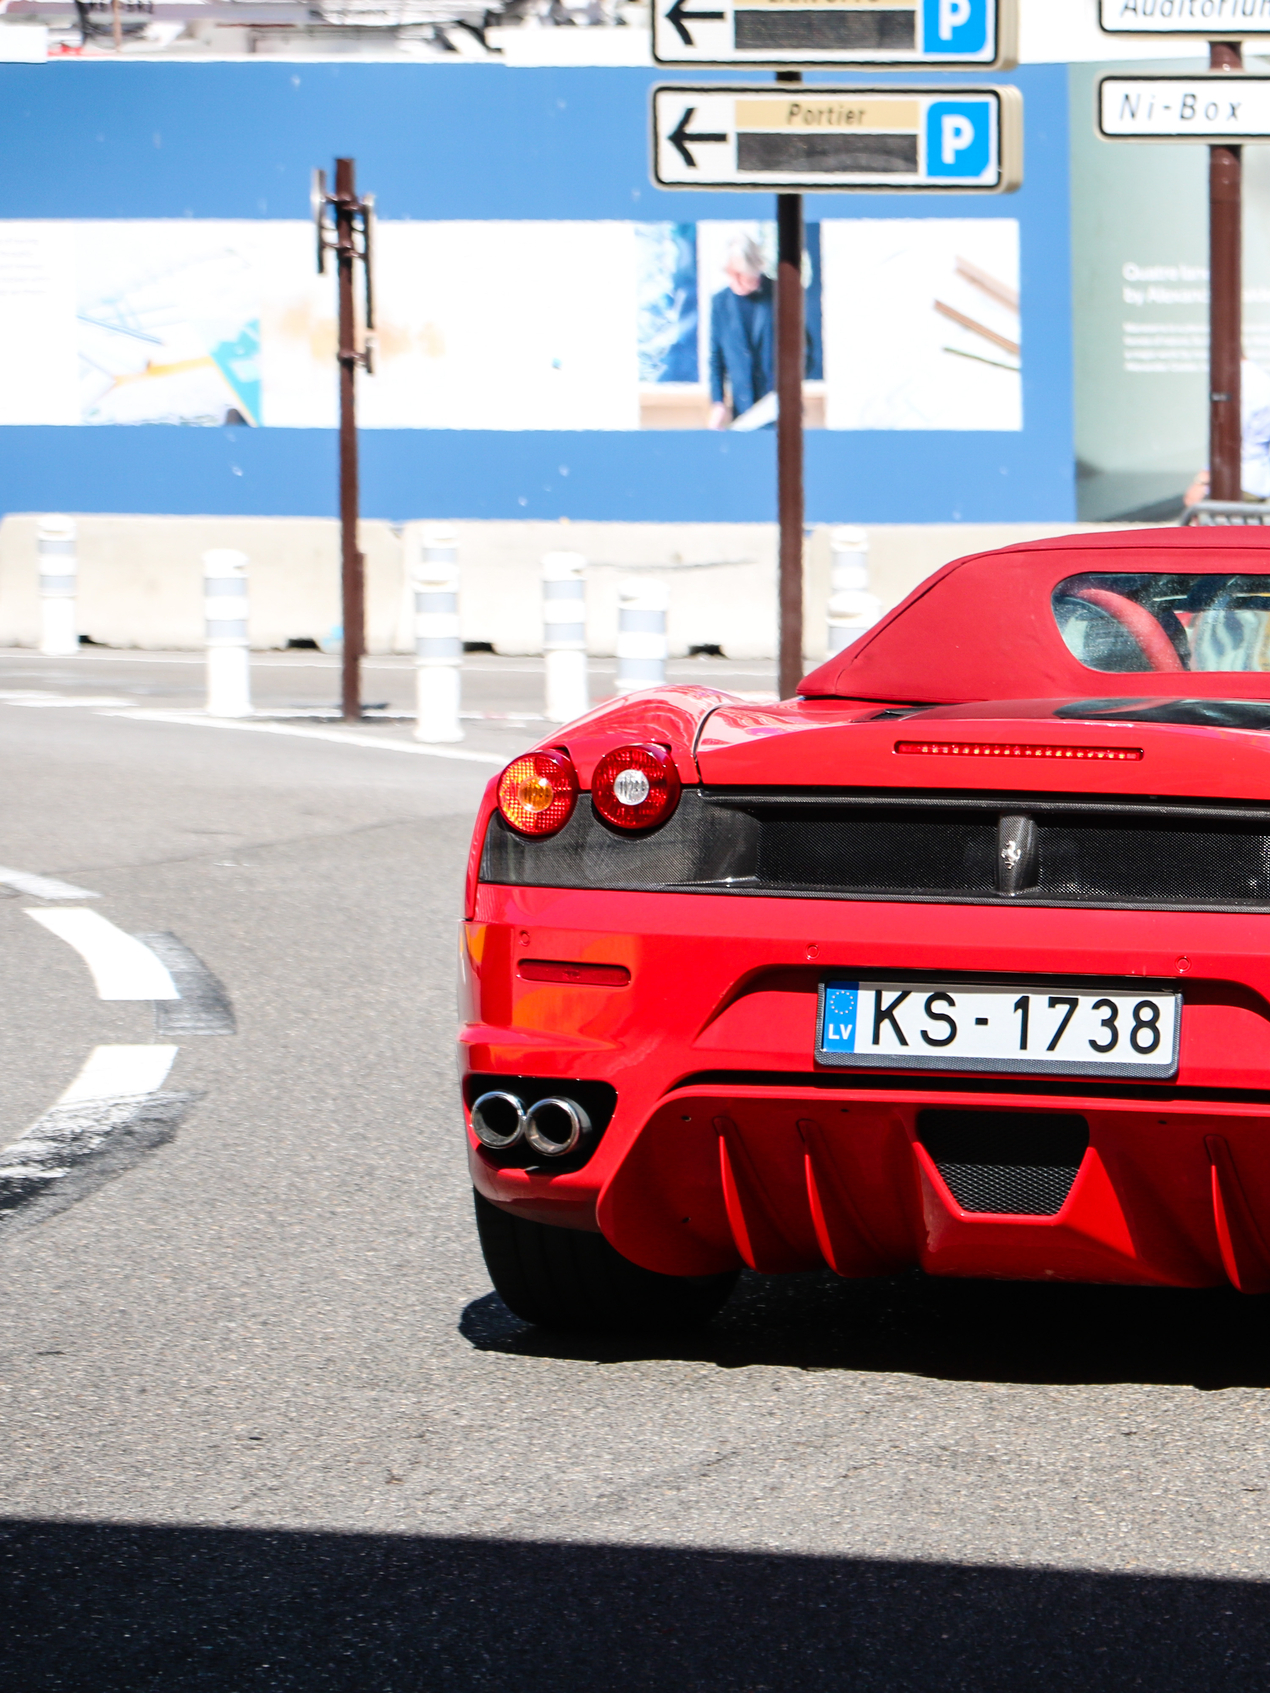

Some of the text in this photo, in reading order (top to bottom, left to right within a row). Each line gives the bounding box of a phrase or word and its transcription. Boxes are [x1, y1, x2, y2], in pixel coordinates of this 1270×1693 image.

[938, 0, 972, 41] P
[786, 103, 867, 127] Portier
[1119, 93, 1243, 122] Ni-Box
[941, 114, 976, 164] P
[828, 1024, 853, 1040] LV
